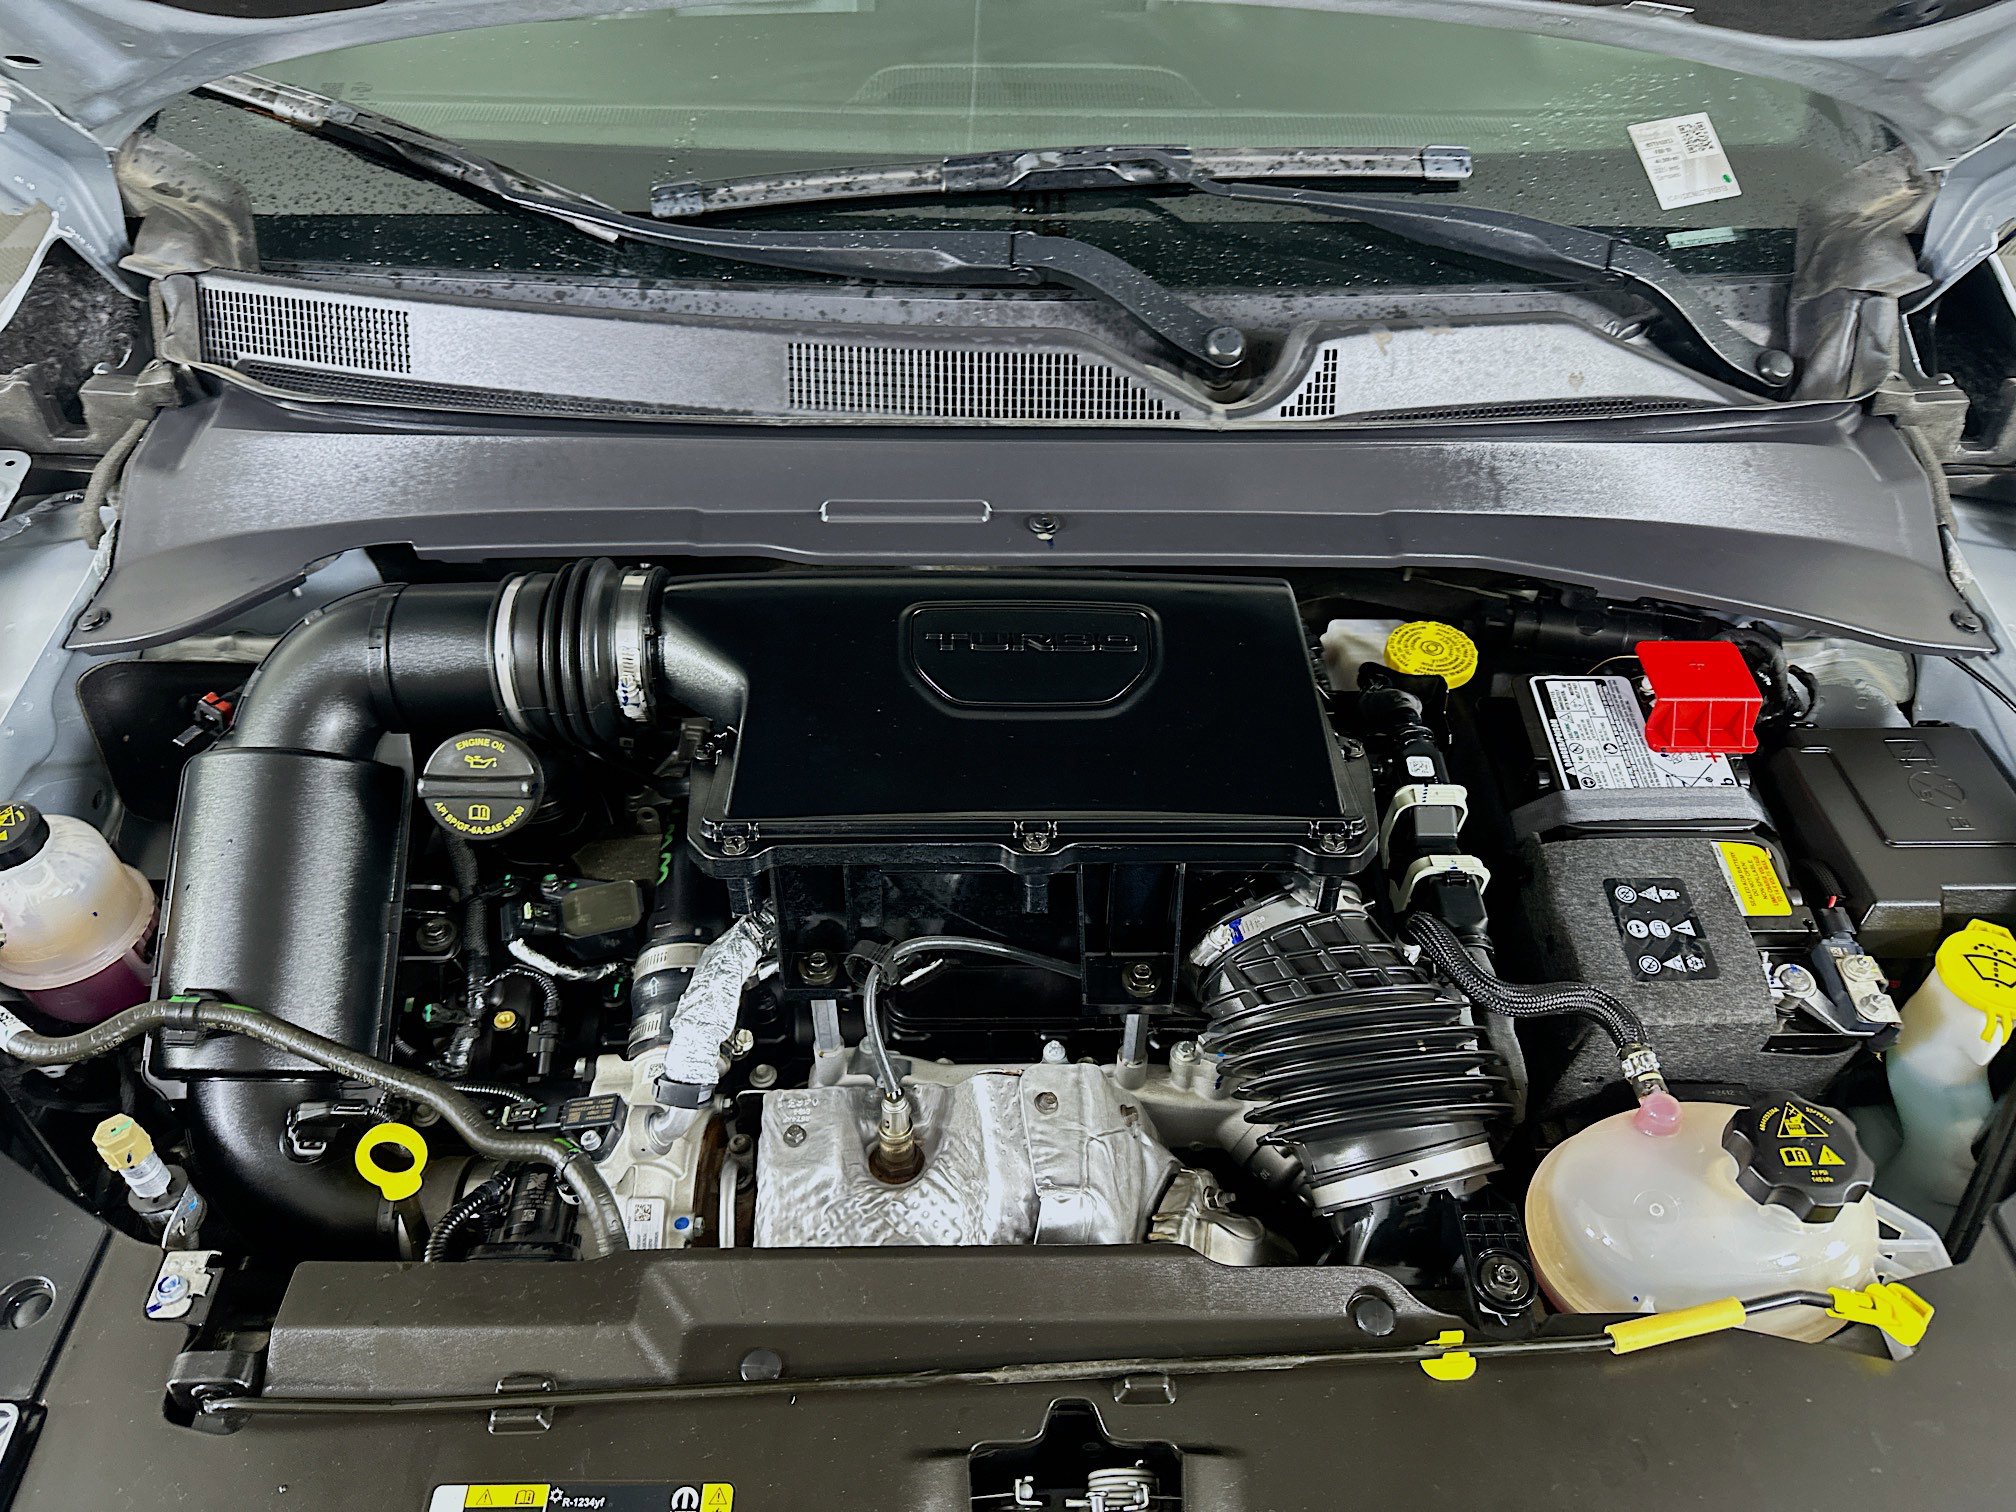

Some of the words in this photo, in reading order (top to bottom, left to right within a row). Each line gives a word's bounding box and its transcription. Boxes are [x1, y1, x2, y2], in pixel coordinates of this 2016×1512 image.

[925, 632, 1138, 652] TURBO
[455, 738, 490, 751] ENGINE
[491, 741, 507, 753] OIL
[434, 802, 449, 817] API
[504, 805, 525, 828] 5W-30
[1730, 852, 1742, 873] BATTERY
[1741, 861, 1750, 877] OPEN
[1739, 875, 1748, 885] AGM
[1744, 885, 1756, 906] SEALED
[562, 1496, 605, 1508] R-1234yf
